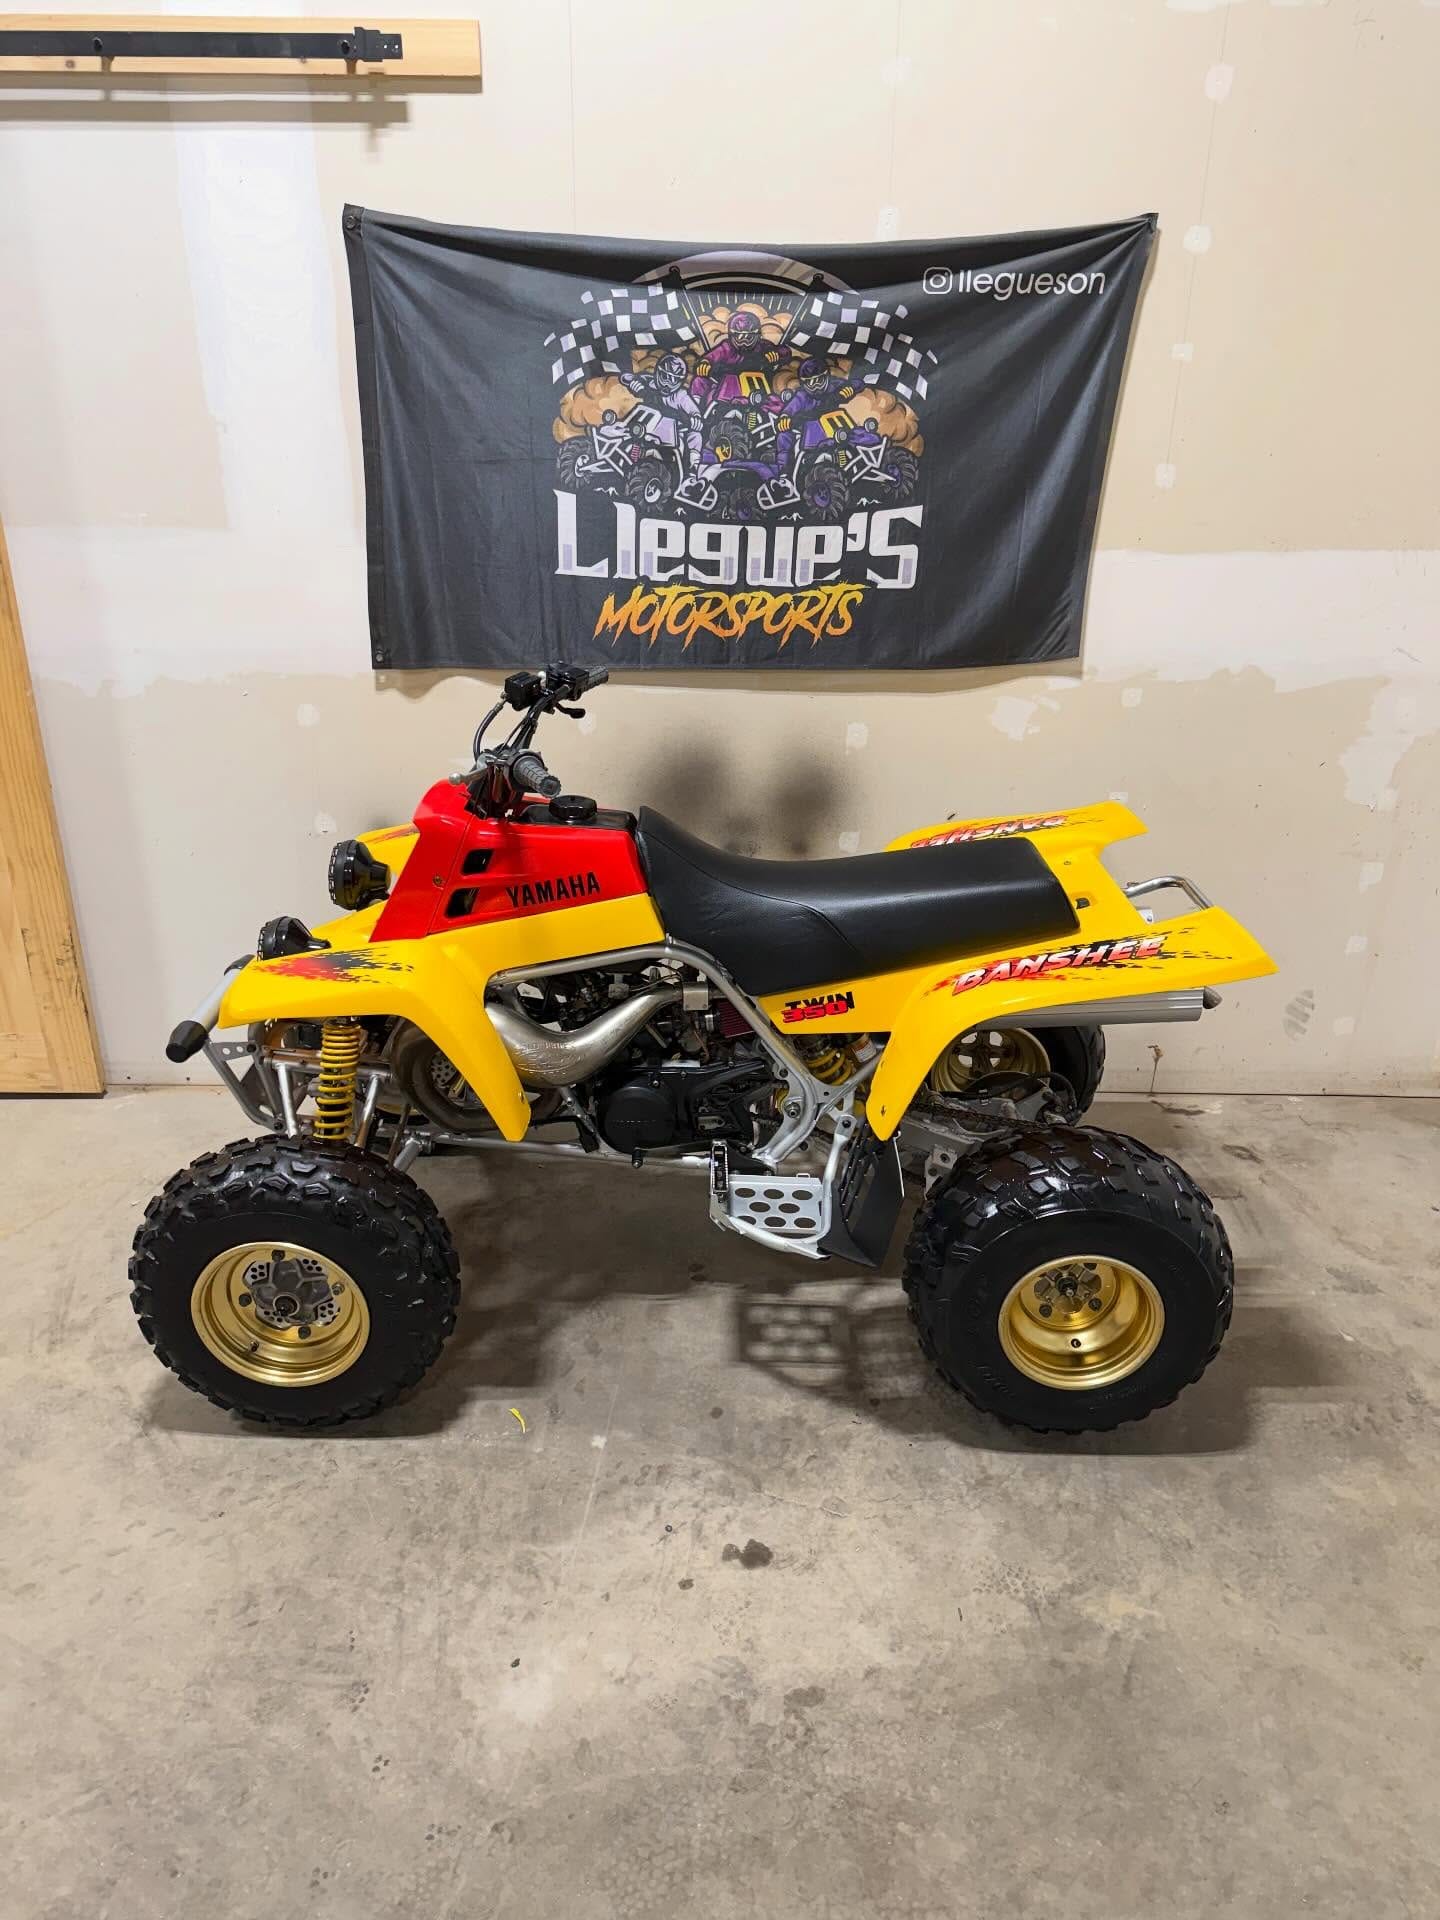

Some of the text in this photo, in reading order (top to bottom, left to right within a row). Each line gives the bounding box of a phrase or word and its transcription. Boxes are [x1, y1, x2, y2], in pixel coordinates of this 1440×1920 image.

[958, 269, 1106, 301] llegueson
[592, 580, 872, 652] MOTORSPORTS
[506, 871, 600, 908] YAMAHA
[952, 936, 1168, 997] BANSHEE
[781, 1000, 849, 1023] 350
[785, 991, 855, 1010] TWIN
